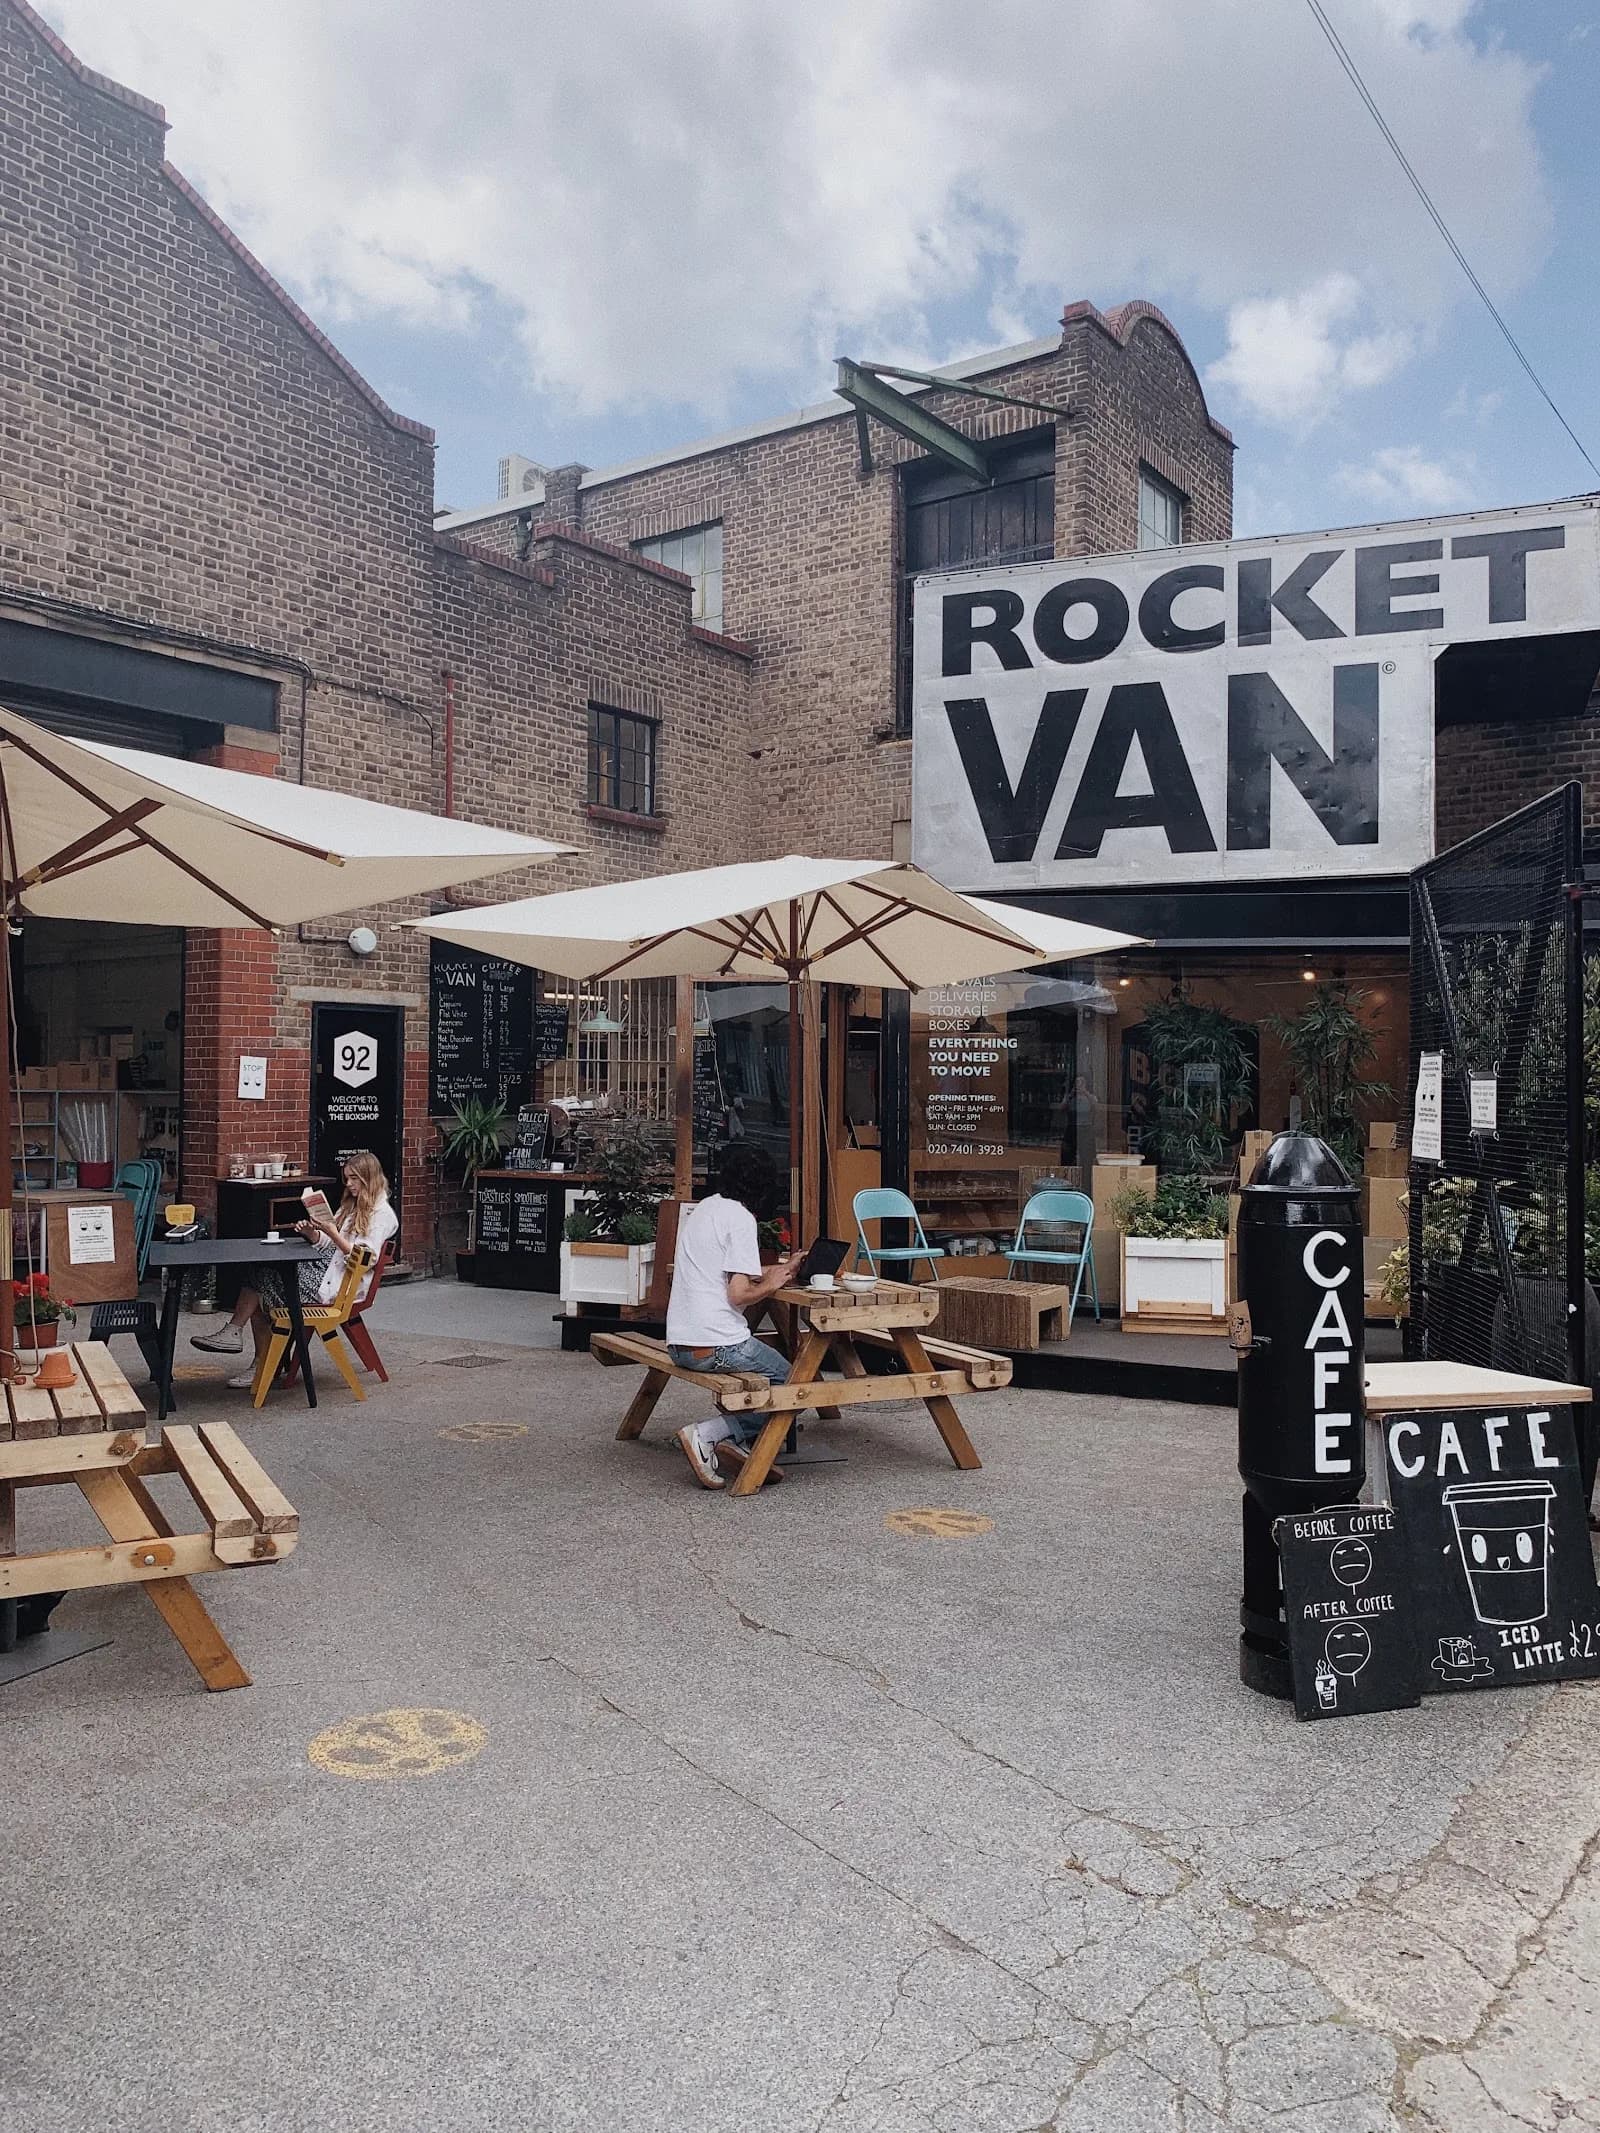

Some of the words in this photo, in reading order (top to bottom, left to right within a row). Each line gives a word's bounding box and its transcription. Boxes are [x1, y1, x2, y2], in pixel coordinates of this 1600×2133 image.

[942, 526, 1566, 677] ROCKET
[943, 662, 1380, 864] VAN
[481, 962, 522, 976] COFFEE
[445, 971, 476, 987] VAN
[499, 981, 515, 993] Large
[929, 991, 997, 1002] DELIVERIES
[928, 1005, 989, 1017] STORAGE
[928, 1019, 970, 1031] BOXES
[928, 1038, 1018, 1049] EVERYTHING
[341, 1045, 371, 1071] 92
[928, 1052, 958, 1063] YOU
[961, 1052, 999, 1063] NEED
[437, 1060, 448, 1068] Tea
[928, 1065, 949, 1077] TO
[951, 1066, 991, 1077] MOVE
[331, 1095, 366, 1104] WELCOME
[367, 1095, 378, 1104] TO
[928, 1094, 967, 1102] OPENING
[968, 1094, 996, 1102] TIMES:
[327, 1104, 372, 1112] ROCKETVAN
[373, 1104, 379, 1112] &
[928, 1104, 948, 1112] MON
[953, 1104, 965, 1112] FRI:
[989, 1105, 1004, 1113] 6PM
[329, 1113, 344, 1121] THE
[345, 1113, 380, 1121] BOXSHOP
[517, 1112, 549, 1123] COLLECT
[928, 1123, 946, 1131] SUN:
[947, 1123, 977, 1131] CLOSED
[512, 1147, 532, 1158] EARN
[928, 1143, 948, 1154] 020
[951, 1144, 973, 1155] 7401
[977, 1144, 1004, 1155] 3928
[477, 1190, 511, 1204] TOASTIES
[514, 1192, 548, 1205] SMOOTHIES
[1303, 1230, 1353, 1474] CAFE
[1388, 1411, 1560, 1478] CAFE
[1294, 1518, 1338, 1538] BEFORE
[1349, 1513, 1394, 1532] COFFEE
[1303, 1600, 1349, 1620] AFTER
[1355, 1594, 1395, 1612] COFFEE
[1498, 1625, 1540, 1648] ICED
[1512, 1641, 1565, 1670] LATTE
